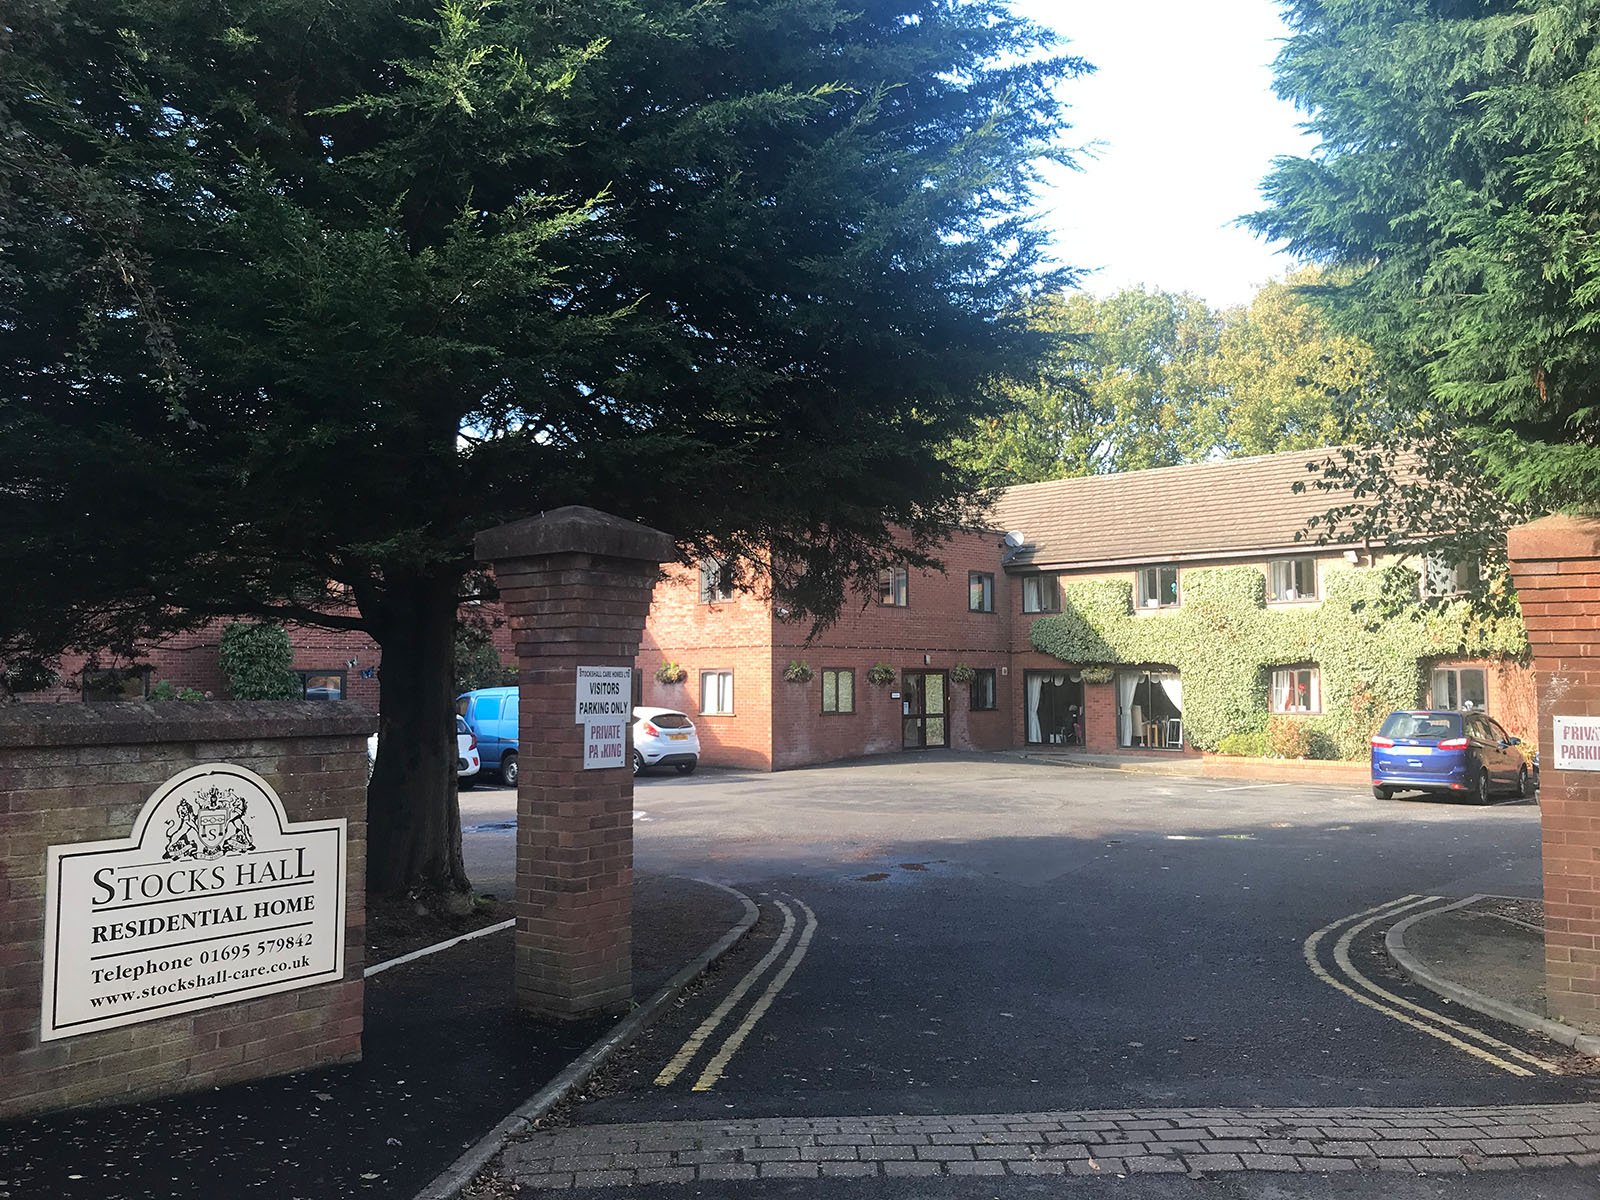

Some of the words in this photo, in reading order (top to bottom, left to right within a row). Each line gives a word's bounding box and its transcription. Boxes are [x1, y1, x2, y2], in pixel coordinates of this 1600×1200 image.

[589, 682, 620, 695] VISITORS
[579, 702, 609, 715] PARKING
[611, 701, 628, 714] ONLY
[591, 725, 621, 740] PRIVATE
[1563, 726, 1600, 741] PRIVA
[589, 743, 622, 759] PAKING
[91, 865, 225, 906] STOCKS
[235, 847, 315, 886] HALL
[91, 905, 247, 944] RESIDENTIAL
[253, 895, 315, 918] HOME
[91, 954, 193, 985] Telephone
[199, 943, 250, 965] 01695
[256, 933, 313, 956] 579842
[89, 955, 310, 1008] www.stockshall-care.co.uk
